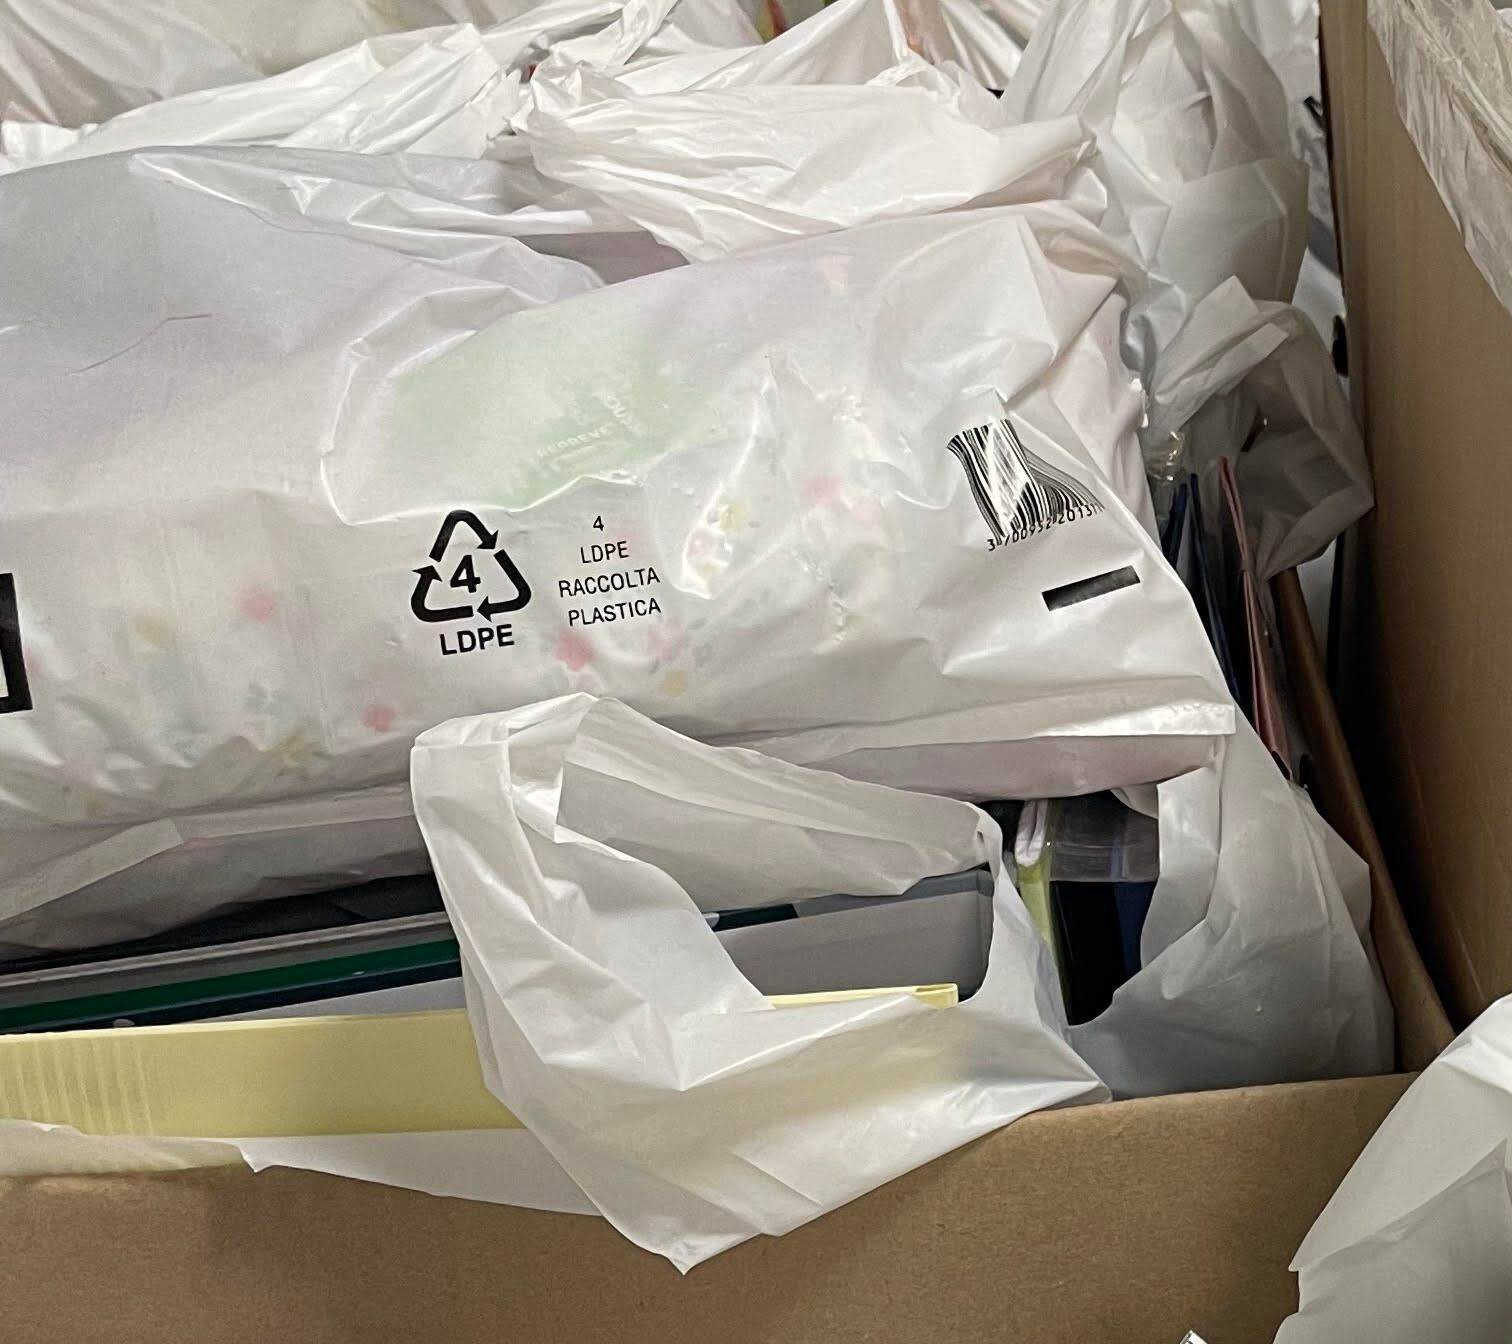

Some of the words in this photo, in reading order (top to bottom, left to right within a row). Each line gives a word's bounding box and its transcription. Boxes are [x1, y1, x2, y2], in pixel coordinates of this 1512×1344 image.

[592, 515, 605, 531] 4
[580, 540, 630, 564] LDPE
[449, 554, 482, 594] 4
[558, 566, 661, 598] RACCOLTA
[568, 597, 662, 627] PLASTICA
[439, 623, 515, 655] LDPE
